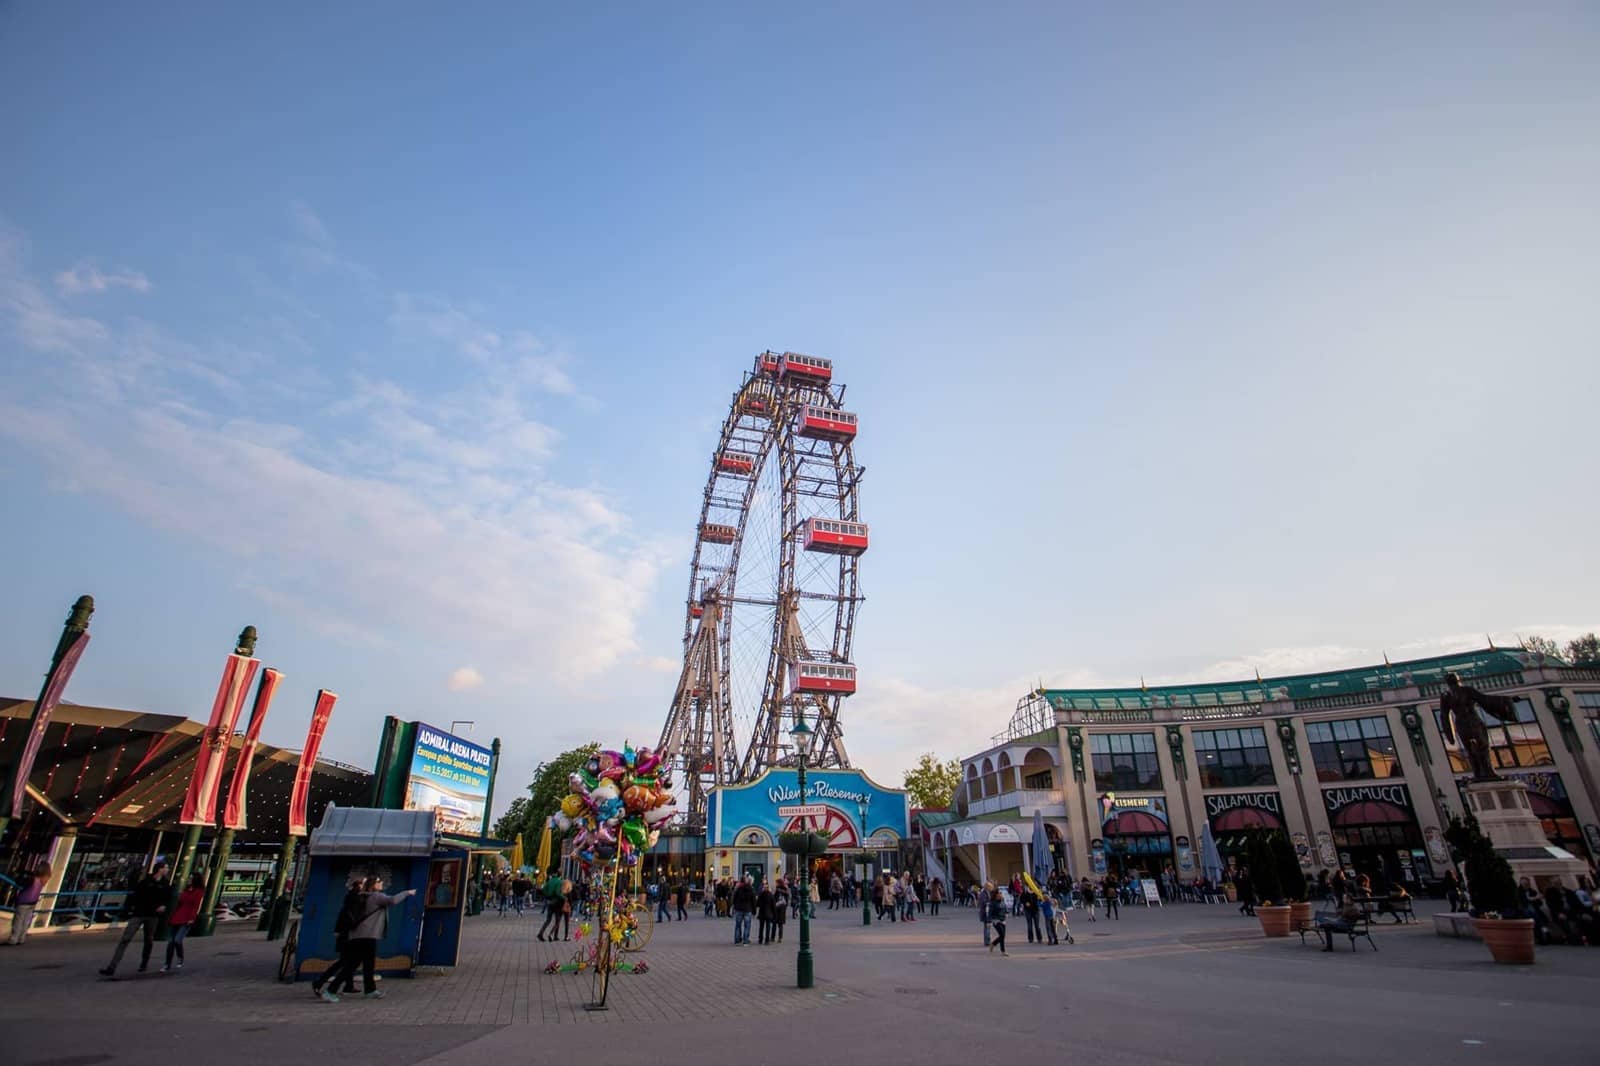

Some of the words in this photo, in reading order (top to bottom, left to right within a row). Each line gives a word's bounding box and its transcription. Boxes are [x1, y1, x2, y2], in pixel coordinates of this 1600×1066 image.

[419, 730, 449, 752] ADMIRAL
[450, 742, 469, 760] ARENA
[814, 780, 872, 803] Riesenrad
[1326, 785, 1408, 810] SALAMUCCI
[1208, 793, 1279, 816] SALAMUCCI
